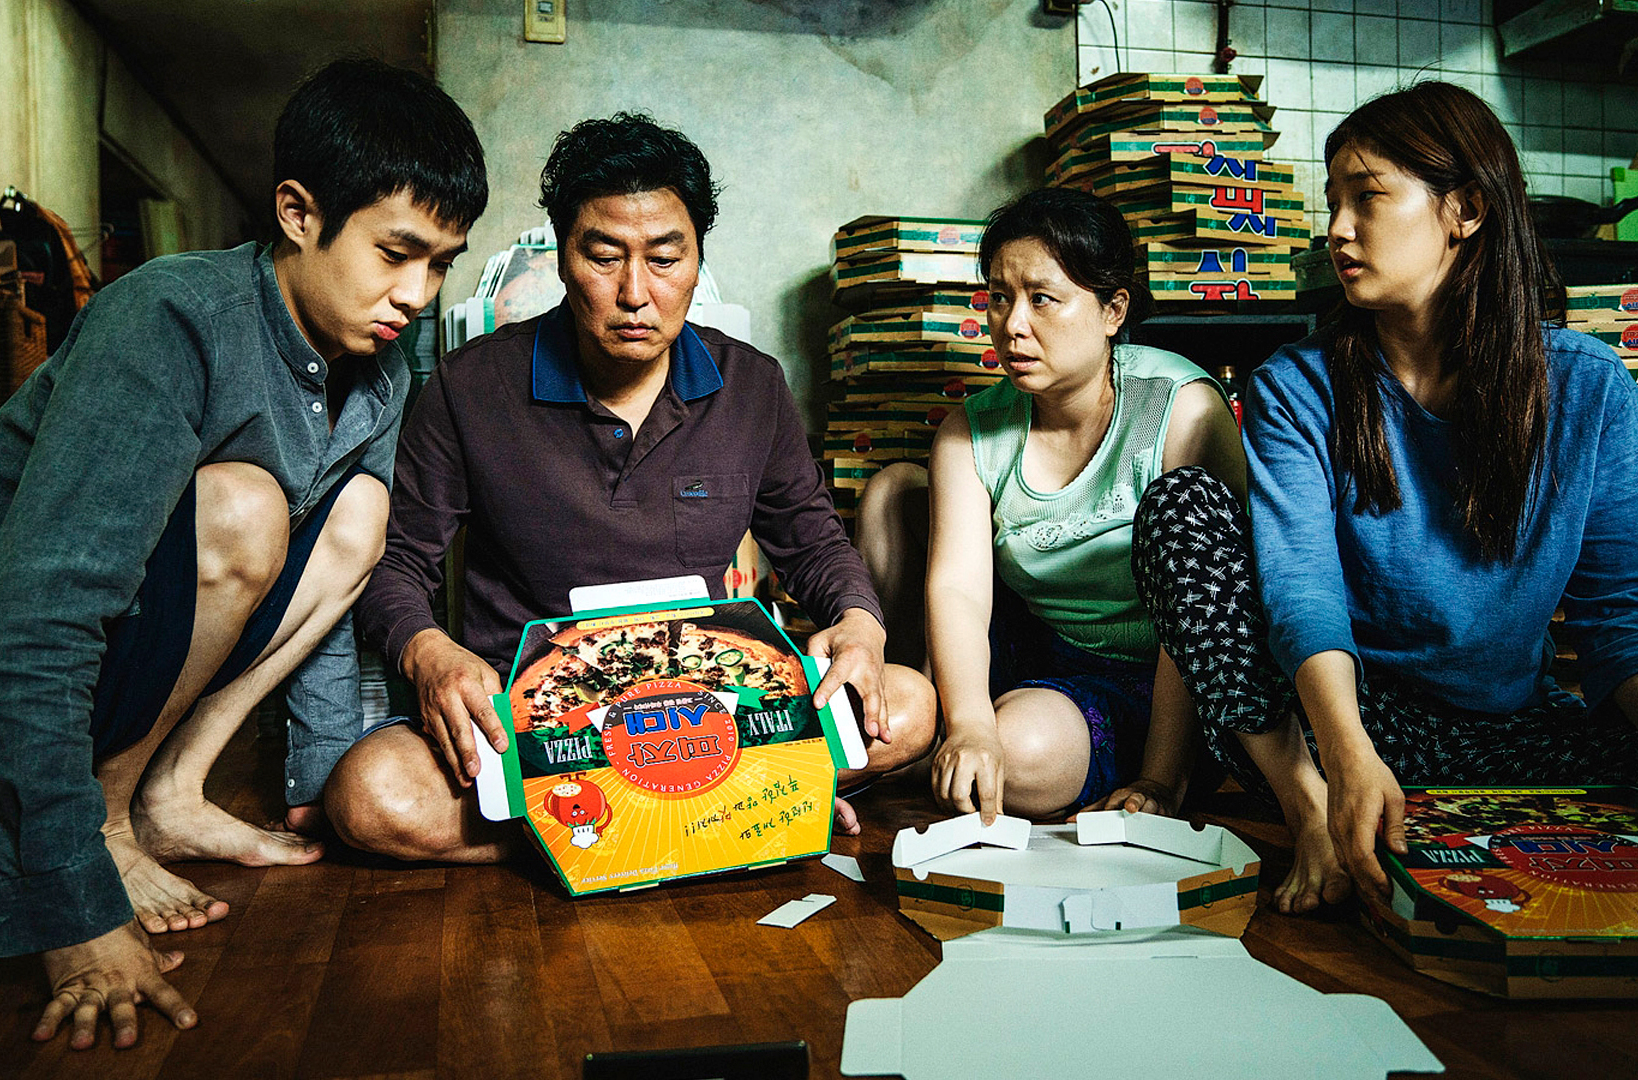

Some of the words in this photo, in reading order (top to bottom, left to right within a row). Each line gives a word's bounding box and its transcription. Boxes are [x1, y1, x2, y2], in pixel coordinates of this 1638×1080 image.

[615, 687, 641, 708] PURE
[646, 681, 682, 690] PIZZA
[697, 689, 728, 715] SINCE
[623, 704, 710, 735] 시대
[725, 719, 735, 742] 2010
[747, 708, 795, 737] ITALY
[543, 734, 594, 765] PIZZA
[604, 723, 616, 757] FRESH
[627, 734, 722, 768] 피자
[621, 767, 702, 792] GENERATION
[705, 754, 732, 781] PIZZA
[761, 774, 799, 804] 푸짐한
[732, 796, 758, 811] 양과
[779, 800, 813, 826] 신선한
[739, 817, 776, 840] 재료와
[1421, 849, 1486, 863] PIZZA
[1509, 839, 1618, 854] 시대
[581, 874, 607, 883] Service
[609, 869, 638, 879] Delivery
